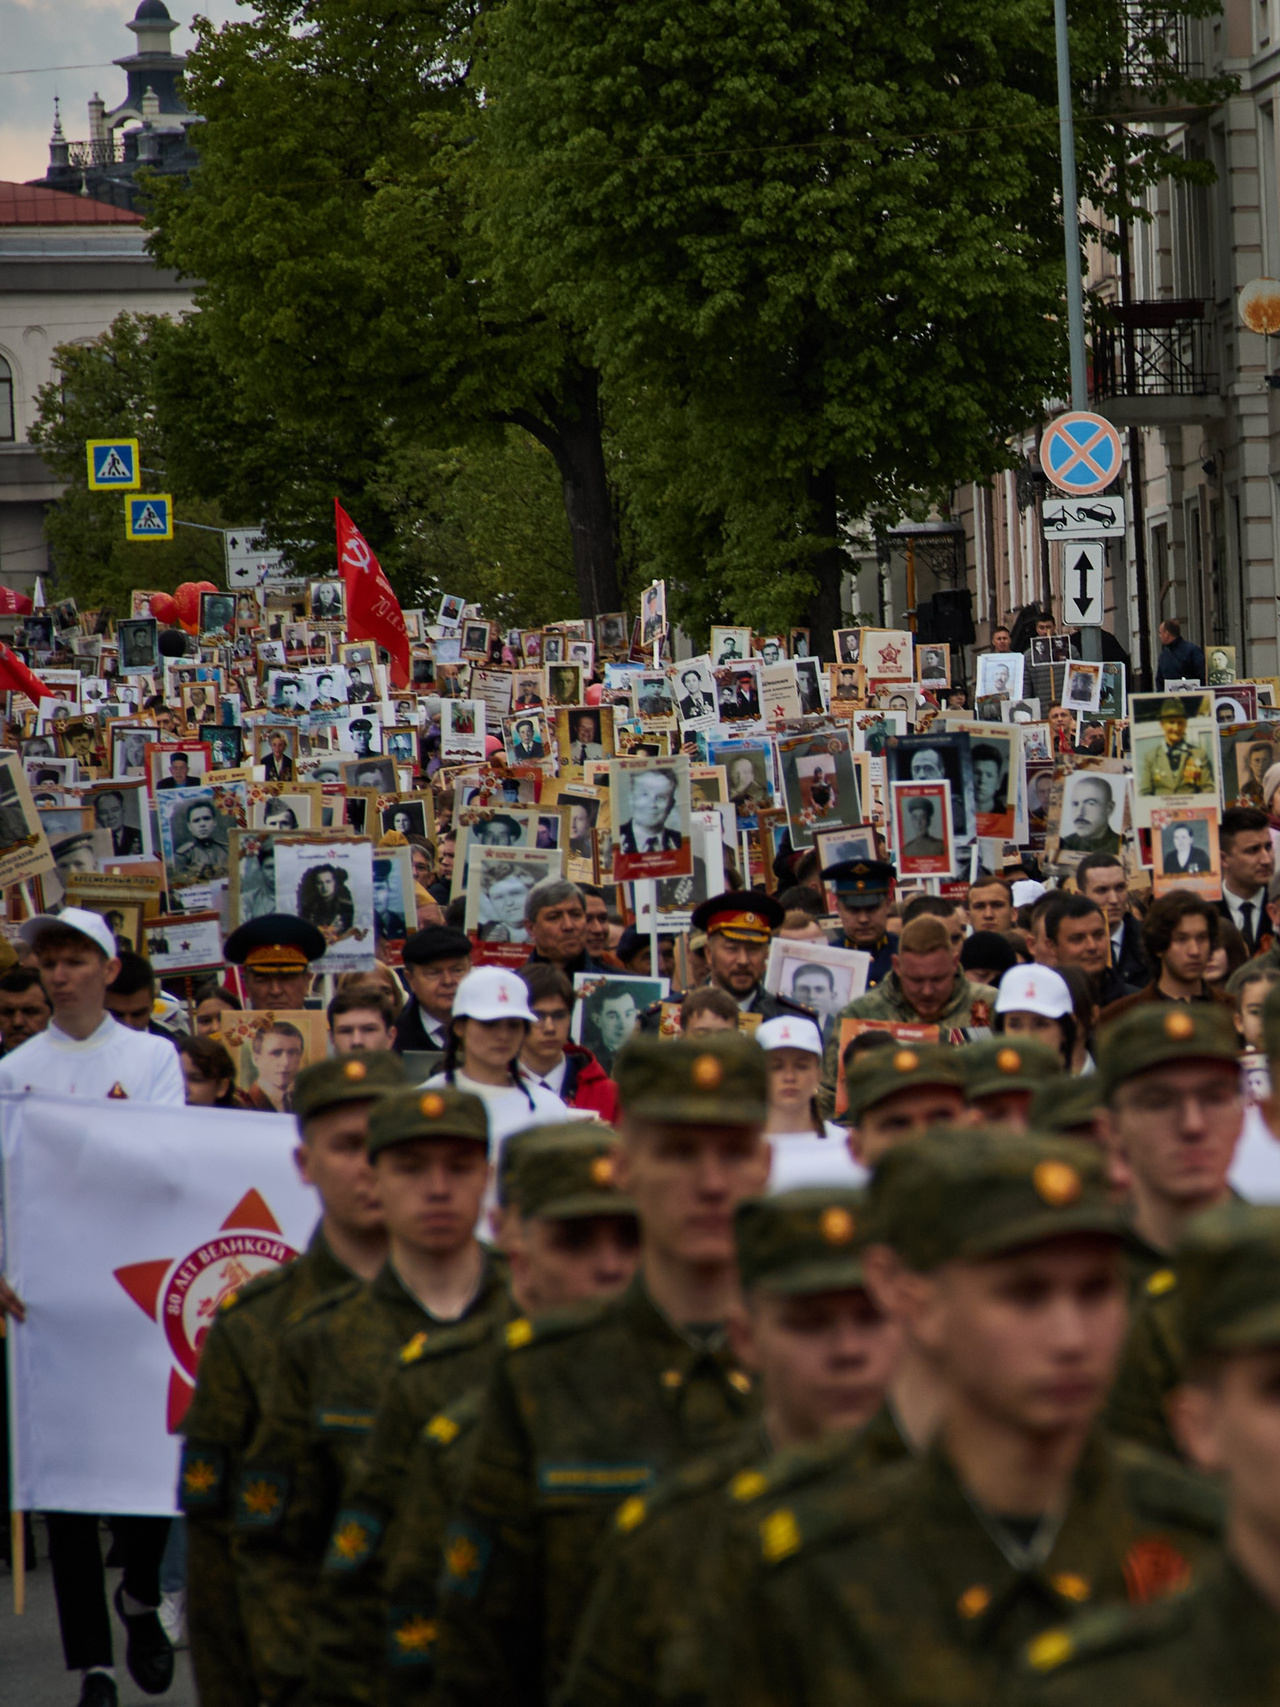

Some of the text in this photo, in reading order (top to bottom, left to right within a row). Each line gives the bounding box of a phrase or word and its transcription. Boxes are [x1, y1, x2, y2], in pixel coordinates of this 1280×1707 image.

[167, 1237, 288, 1316] 80 ЛЕТ ВЕЛИКОЙ
